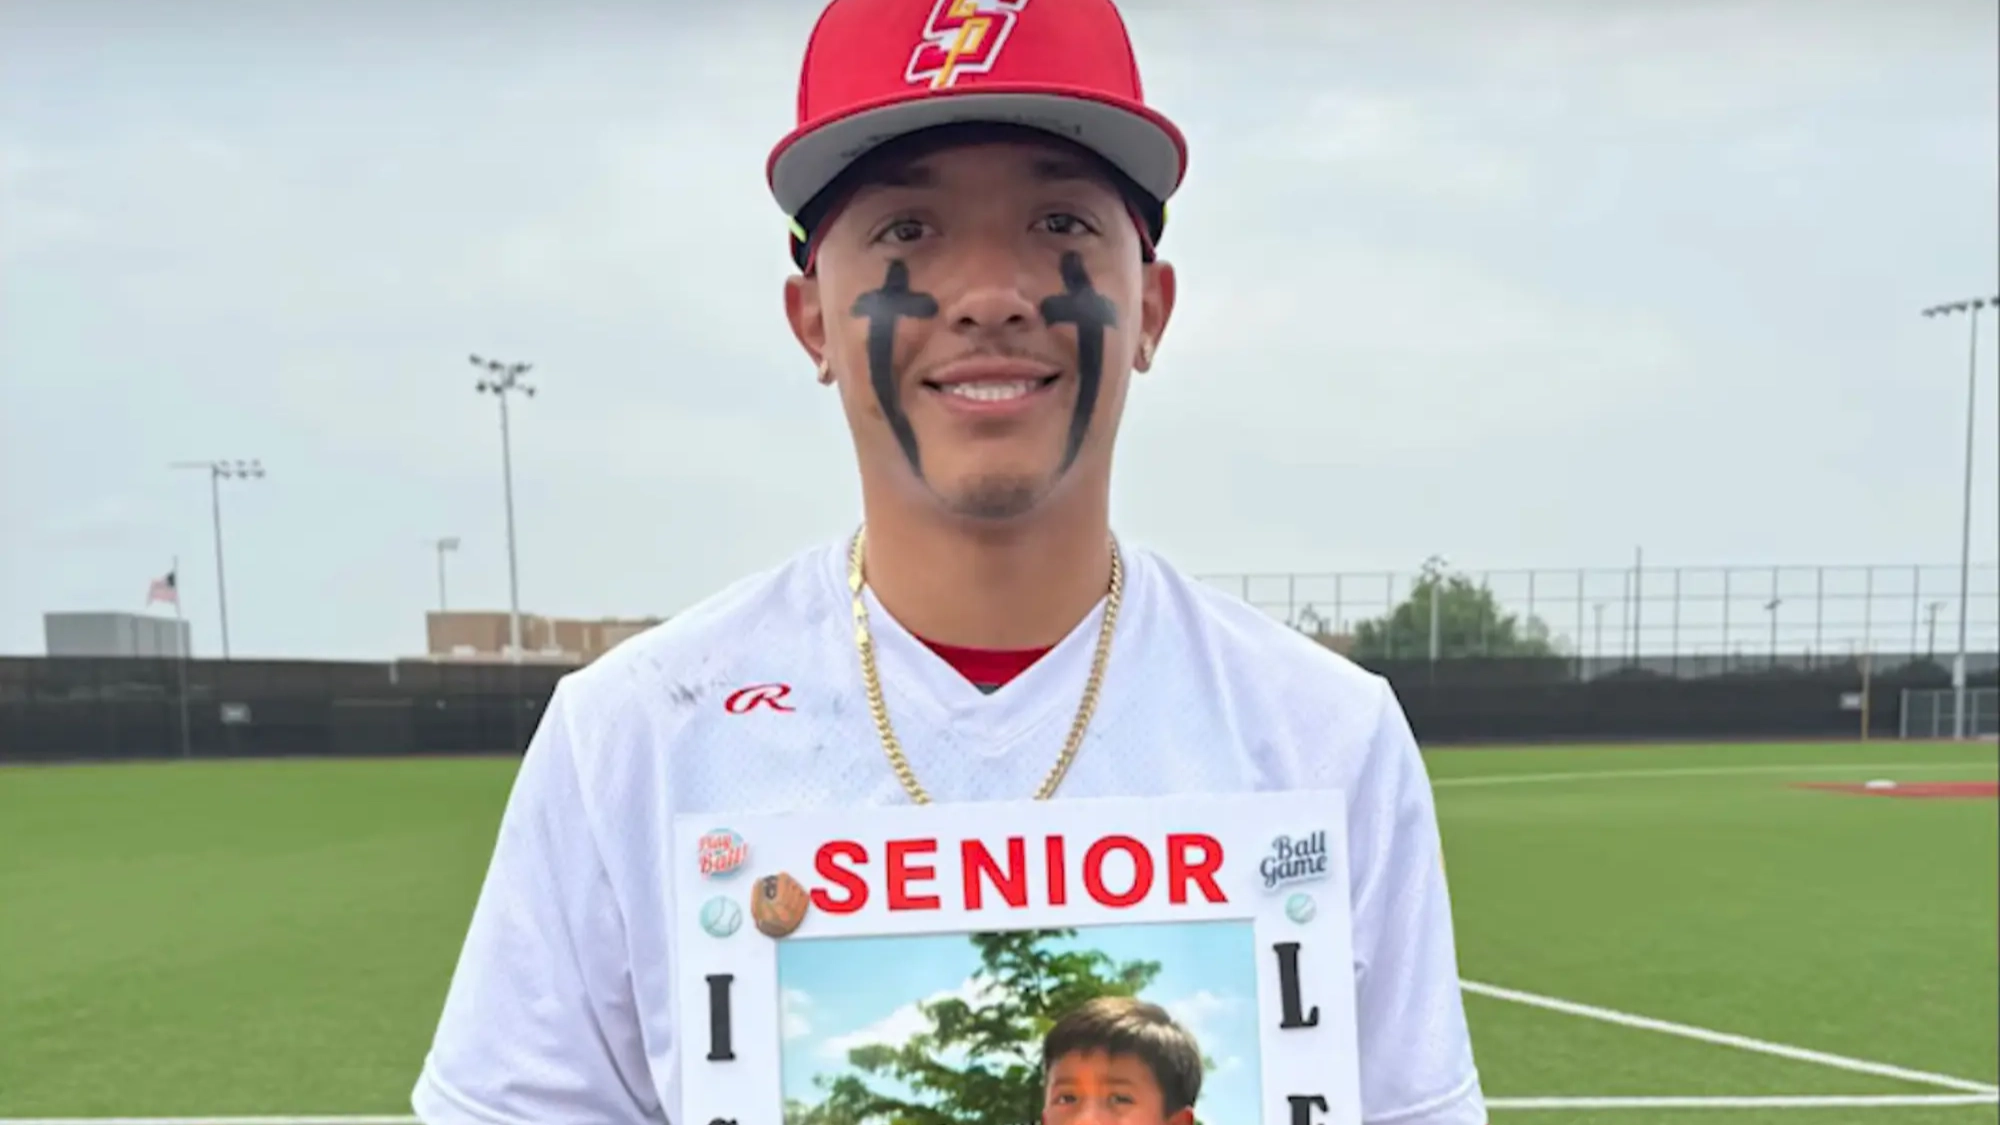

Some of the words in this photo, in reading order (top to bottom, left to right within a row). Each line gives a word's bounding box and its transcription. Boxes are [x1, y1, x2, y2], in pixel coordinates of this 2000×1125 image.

[1271, 830, 1326, 860] Ball
[809, 833, 1228, 914] SENIOR
[1259, 855, 1328, 888] Game
